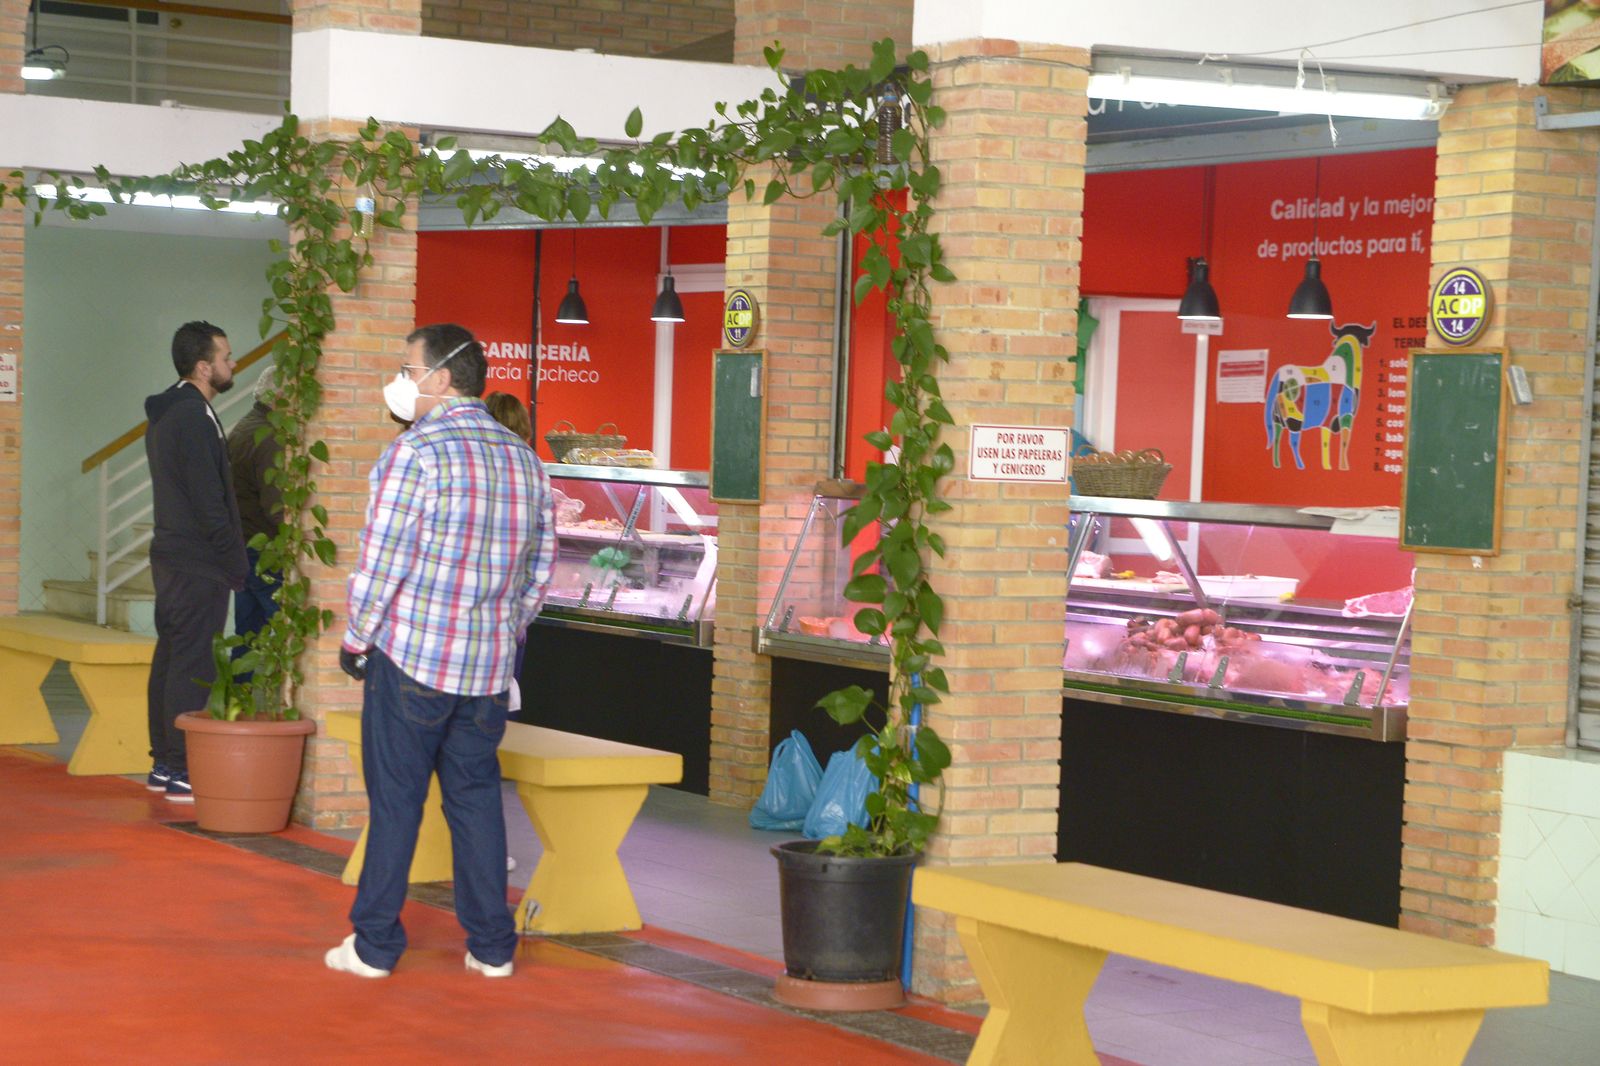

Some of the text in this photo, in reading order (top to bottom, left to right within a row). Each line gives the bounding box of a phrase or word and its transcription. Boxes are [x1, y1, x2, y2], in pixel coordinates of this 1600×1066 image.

[1270, 194, 1434, 221] Calidad y la mejor
[1257, 230, 1425, 261] de productos para tí,
[1453, 281, 1466, 294] 14
[735, 300, 742, 310] 11
[1436, 298, 1483, 314] ACDP
[726, 312, 752, 325] ACDP
[1451, 319, 1464, 332] 14
[734, 328, 742, 338] 11
[480, 341, 591, 362] CARNICERÍA
[997, 432, 1045, 445] POR FAVOR
[977, 447, 1063, 462] USEN LAS PAPELERAS
[992, 463, 1046, 476] Y CENICEROS
